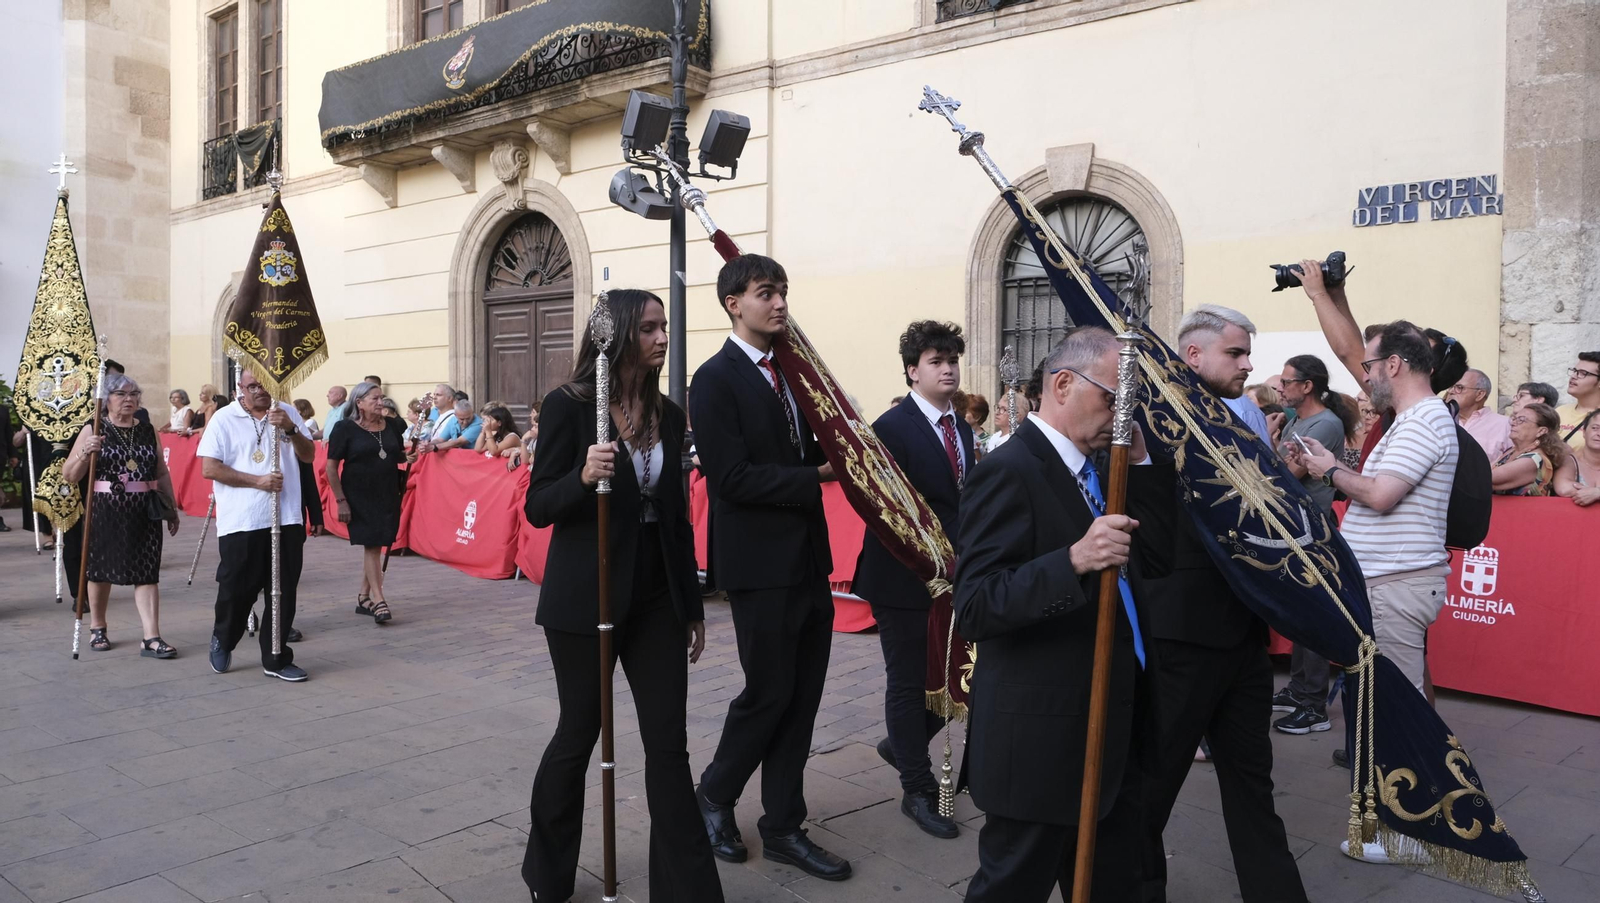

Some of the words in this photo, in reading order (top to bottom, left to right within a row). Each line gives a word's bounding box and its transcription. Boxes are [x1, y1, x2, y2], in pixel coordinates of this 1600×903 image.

[1359, 174, 1497, 206] VIRGEN
[1354, 203, 1416, 228] DEL
[1431, 194, 1502, 221] MAR
[262, 299, 299, 309] Hermandad
[251, 310, 273, 320] Virgen
[273, 307, 285, 315] del
[285, 308, 311, 317] Carmen
[1452, 610, 1496, 625] CIUDAD
